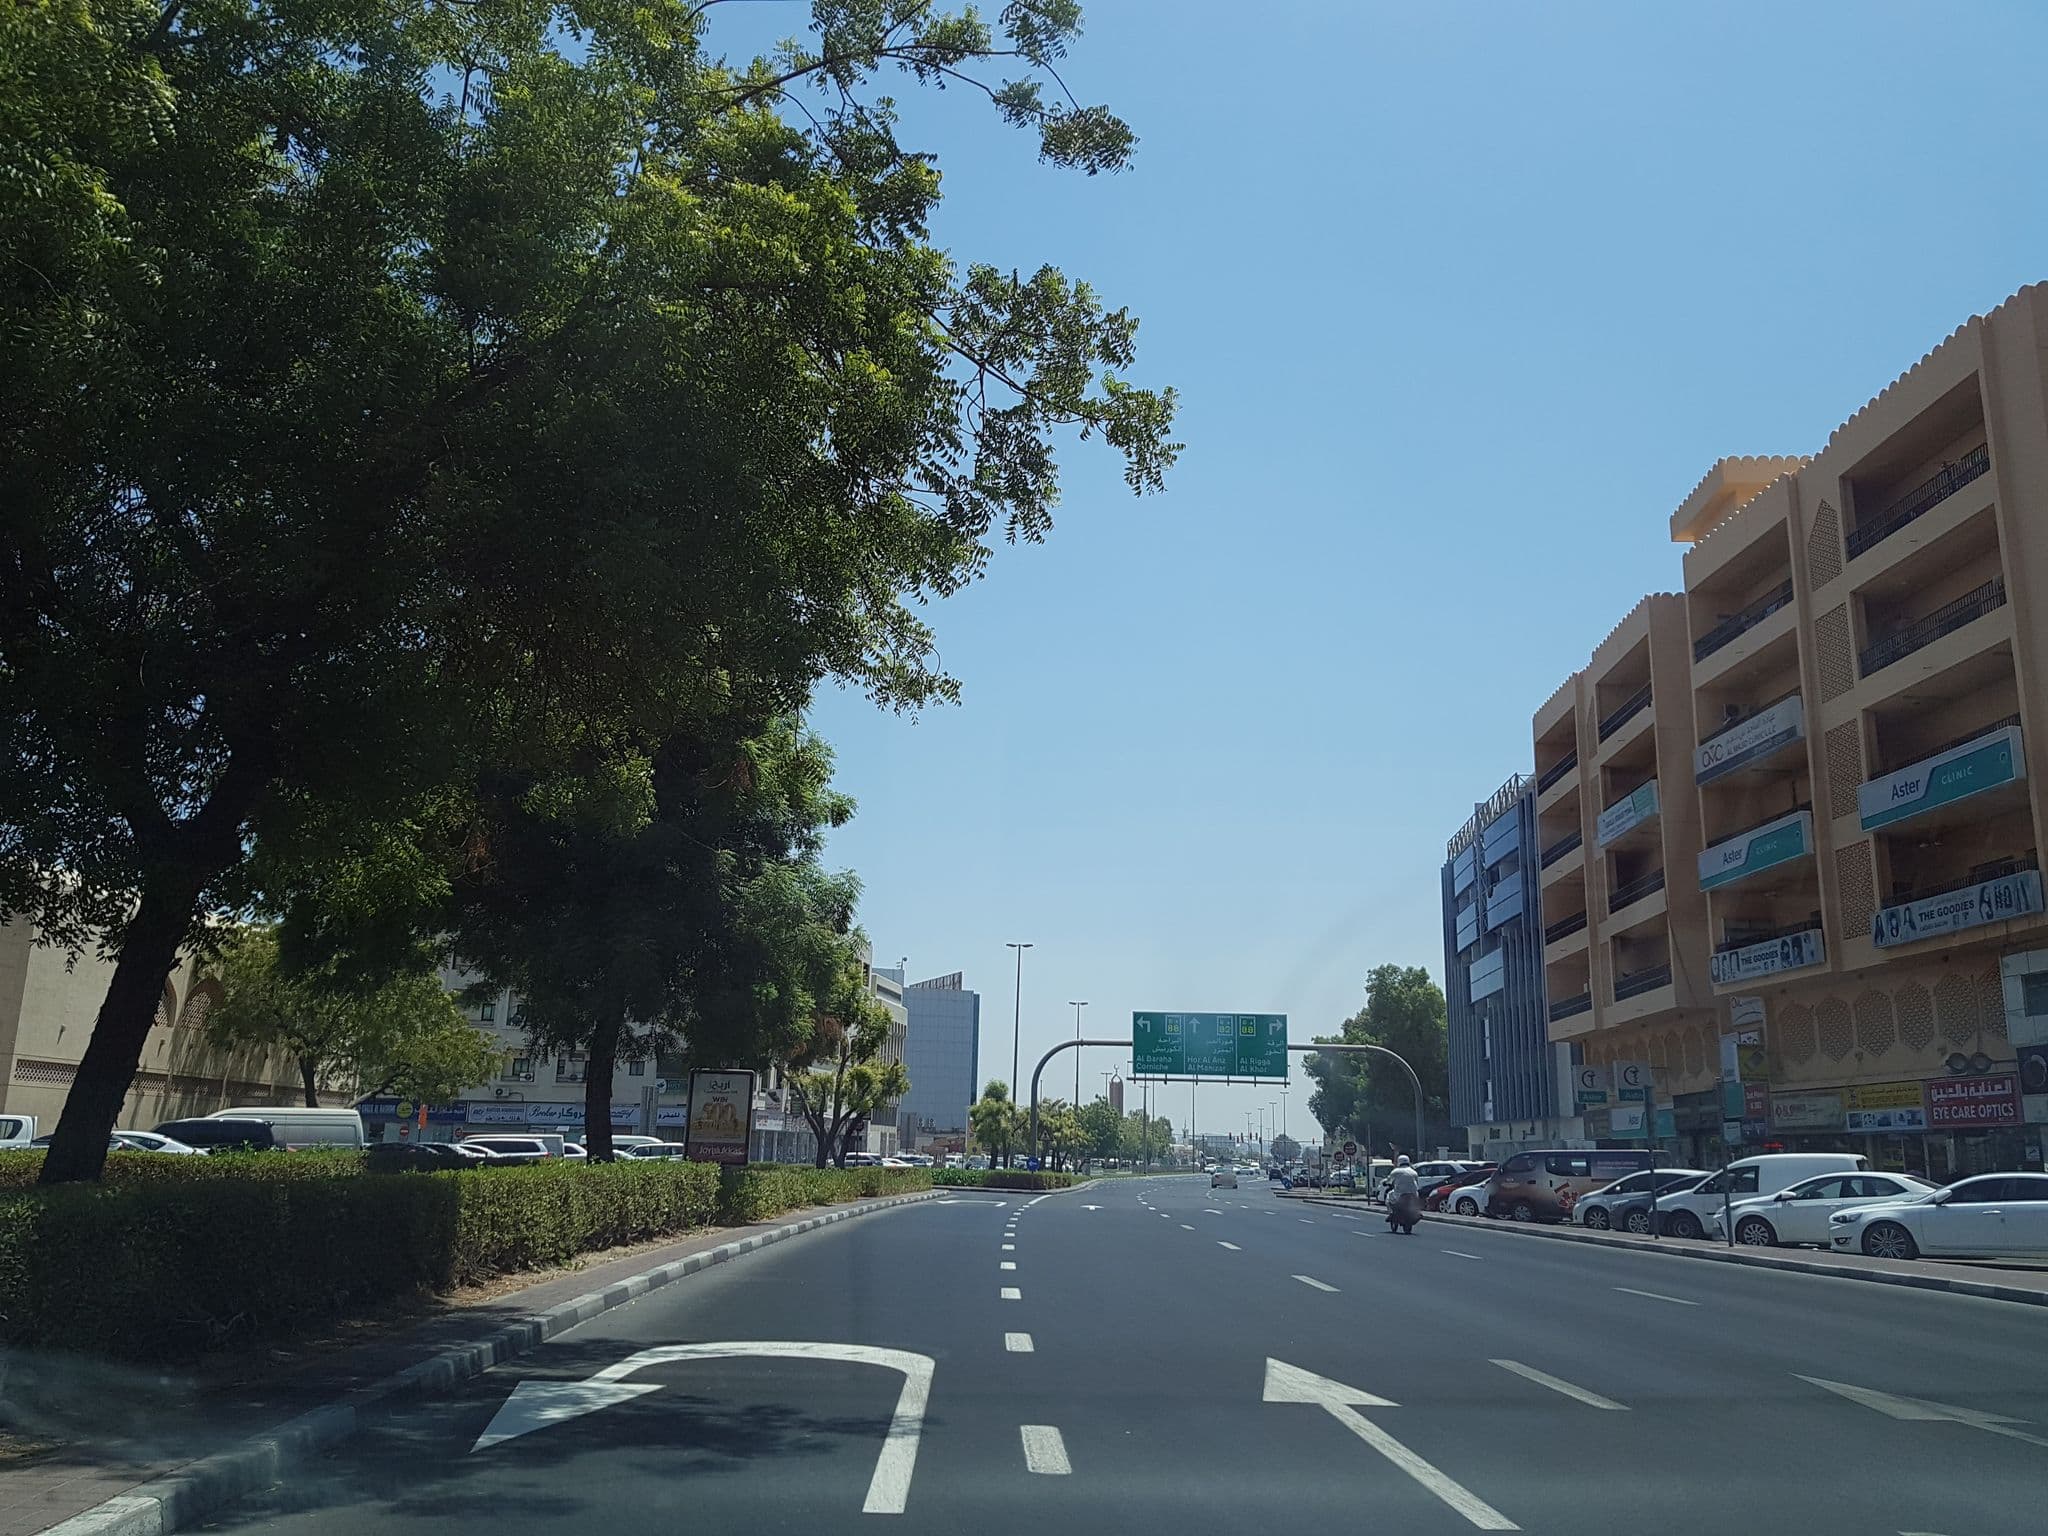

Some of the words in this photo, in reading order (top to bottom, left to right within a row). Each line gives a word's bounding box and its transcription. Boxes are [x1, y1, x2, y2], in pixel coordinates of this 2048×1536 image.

[1892, 778, 1921, 800] Aster
[1941, 765, 1975, 785] CLINIC
[1723, 848, 1743, 865] Aster
[1918, 910, 1935, 923] THE
[1937, 899, 1975, 917] GOODIES
[1741, 956, 1752, 965] THE
[1753, 949, 1779, 963] GOODIES
[1136, 1062, 1169, 1071] Corniche
[1187, 1056, 1199, 1064] Hor
[1187, 1063, 1195, 1071] Al
[1250, 1057, 1271, 1066] Rigga
[1249, 1065, 1268, 1073] Khor
[1931, 1083, 1968, 1102] بالعين
[1969, 1079, 2012, 1099] العناية
[557, 1106, 585, 1119] روكار
[1933, 1106, 1950, 1120] EYE
[1951, 1105, 1977, 1119] CARE
[1978, 1103, 2014, 1117] OPTICS
